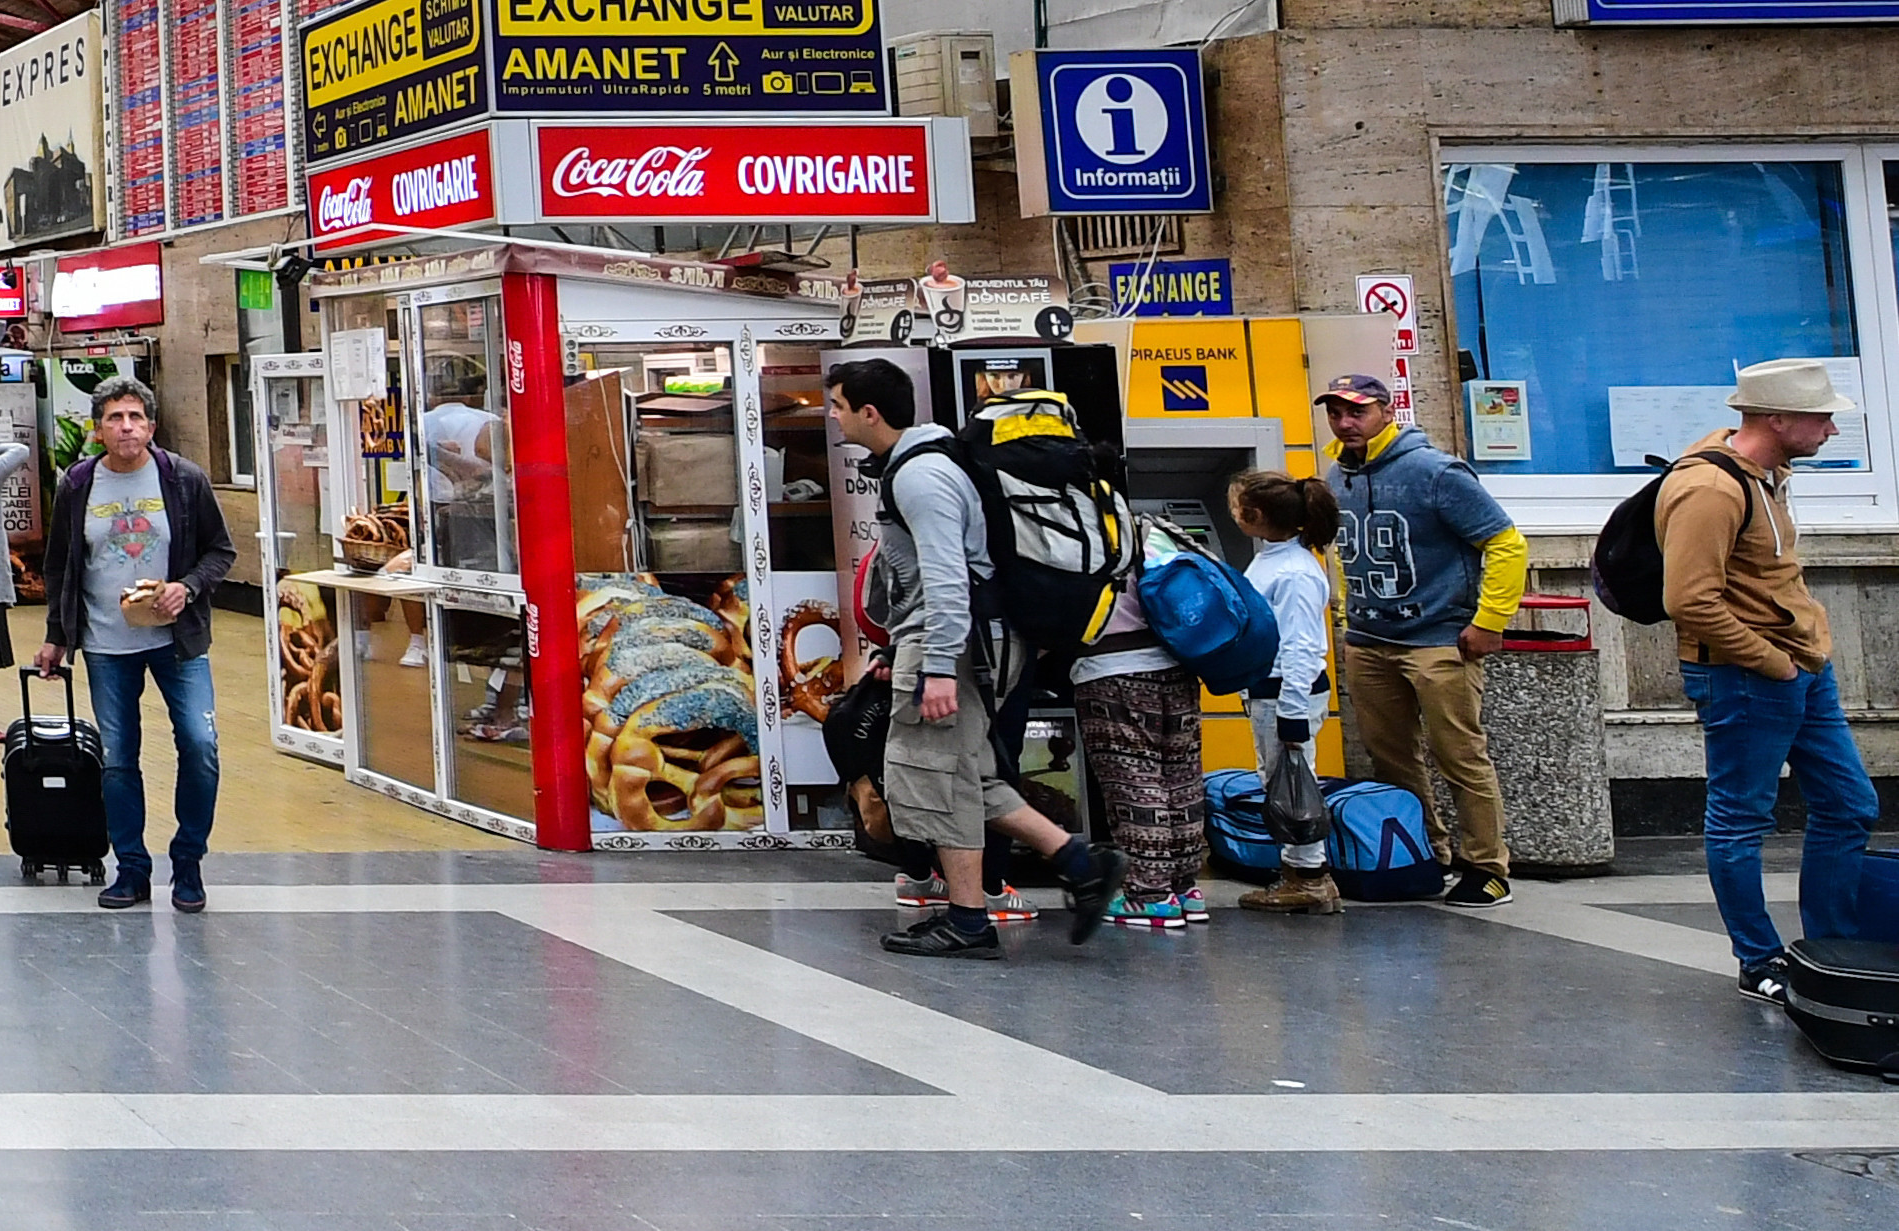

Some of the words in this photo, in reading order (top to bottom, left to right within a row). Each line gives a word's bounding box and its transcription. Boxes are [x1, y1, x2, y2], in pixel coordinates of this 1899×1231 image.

[775, 5, 855, 22] VALUTAR
[427, 16, 470, 49] VALUTAR
[310, 7, 418, 92] EXCHANGE
[502, 47, 687, 81] AMANET
[761, 48, 785, 60] Aur
[802, 47, 876, 60] Electronice
[2, 37, 86, 107] EXPRES
[394, 65, 480, 128] AMANET
[603, 83, 691, 97] UltraRapide
[703, 83, 711, 96] 5
[713, 83, 752, 96] metri
[392, 154, 480, 217] COVRIGARIE
[552, 146, 713, 197] Coca-Cola
[737, 155, 916, 195] COVRIGARIE
[1075, 166, 1181, 193] Informații
[966, 279, 1027, 288] MOMENTUL
[1028, 278, 1049, 287] TĂU
[967, 289, 1052, 304] DONCAFÉ
[1116, 271, 1221, 305] EXCHANGE
[508, 337, 526, 395] Coca-Cola
[1131, 346, 1192, 363] PIRAEUS
[1196, 346, 1238, 361] BANK
[4, 519, 34, 531] OC!
